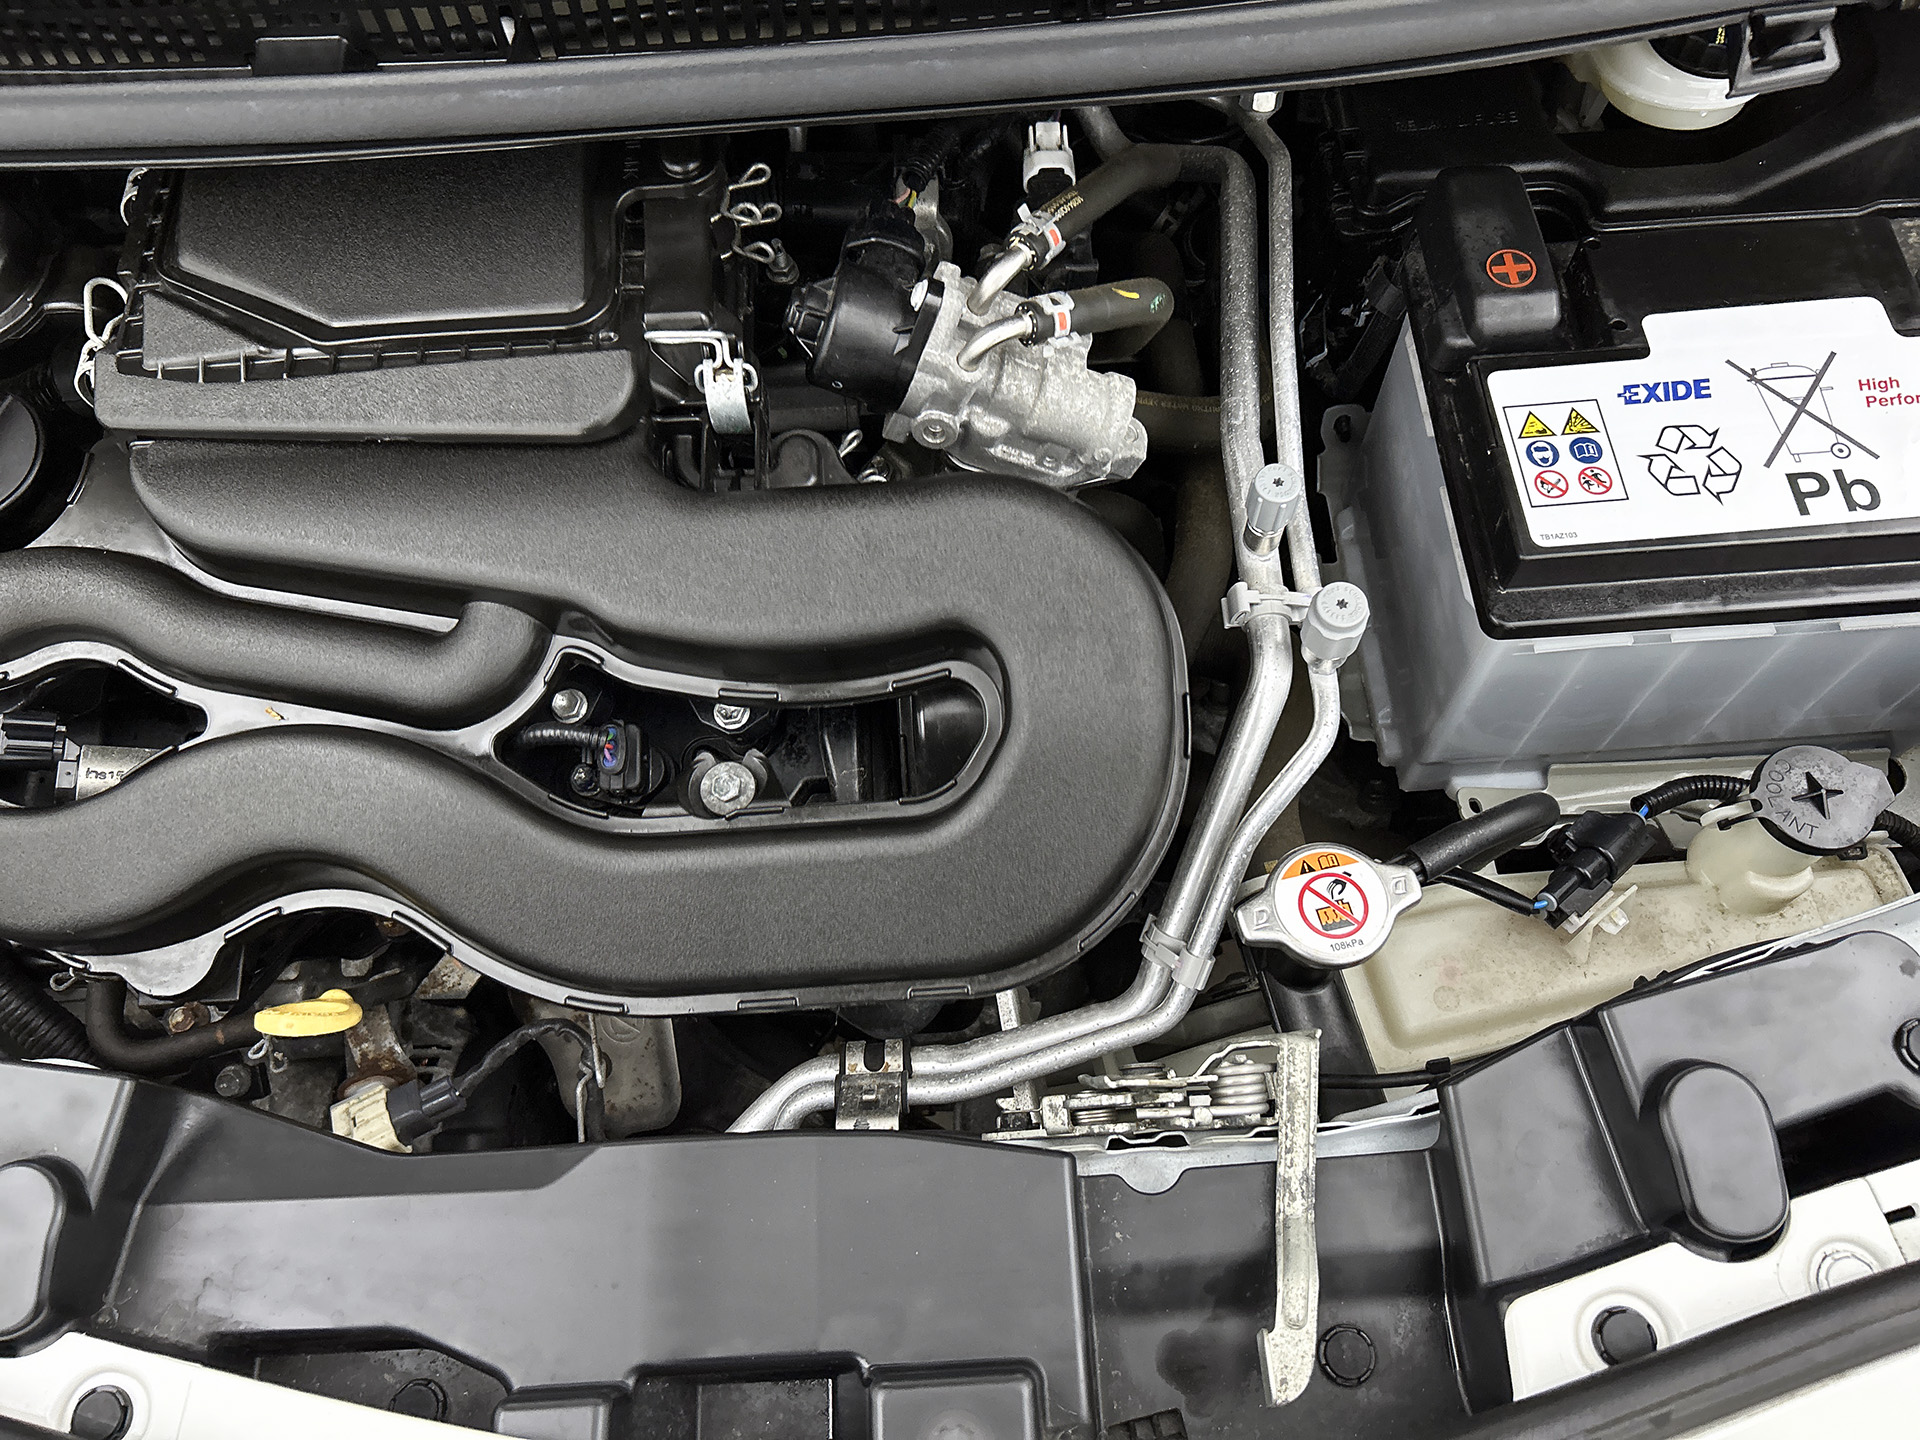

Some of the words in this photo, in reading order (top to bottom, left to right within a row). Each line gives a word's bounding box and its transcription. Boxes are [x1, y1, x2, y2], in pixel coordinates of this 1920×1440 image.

[1617, 378, 1712, 405] EXIDE
[1858, 376, 1900, 393] High
[1785, 469, 1881, 516] Pb
[1539, 531, 1578, 541] TB1AZ103
[1765, 758, 1819, 839] COOLANT
[1330, 938, 1364, 952] 108kPa
